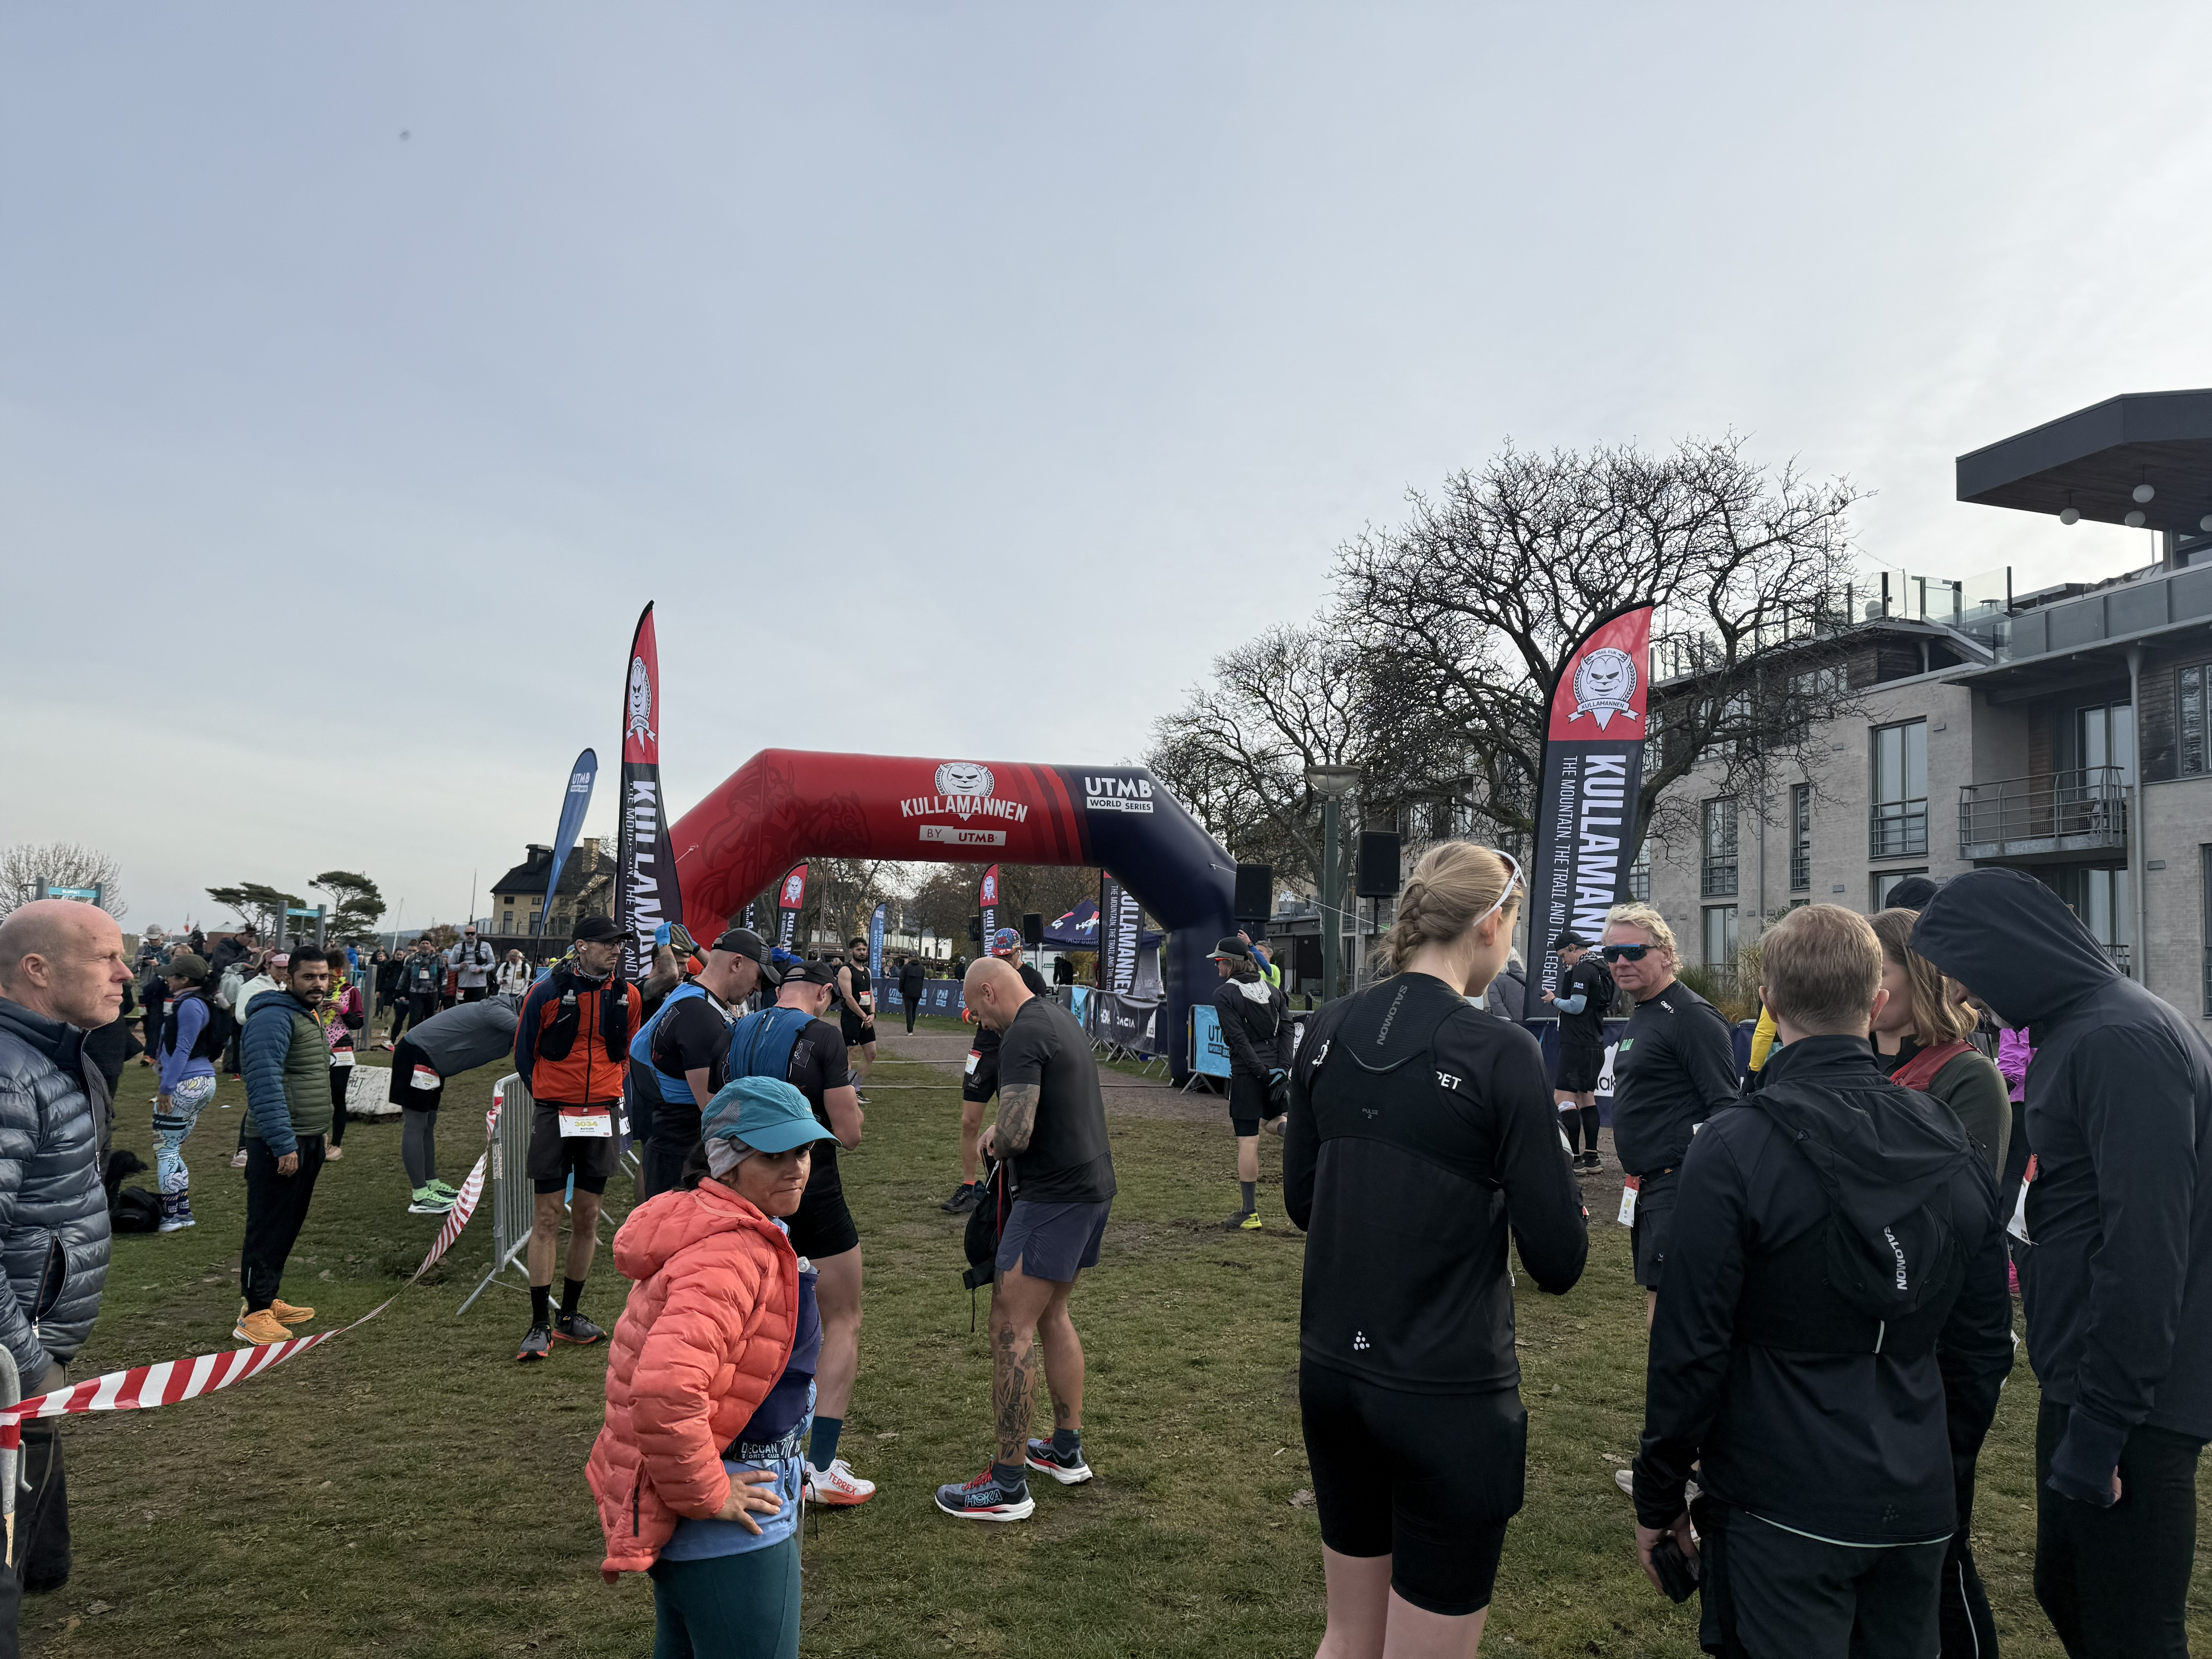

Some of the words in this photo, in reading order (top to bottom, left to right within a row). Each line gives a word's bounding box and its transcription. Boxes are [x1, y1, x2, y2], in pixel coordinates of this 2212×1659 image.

[1582, 701, 1624, 709] KULLAMANNEN
[1562, 756, 1577, 776] THE
[572, 772, 590, 784] UTMB
[1085, 777, 1152, 798] UTMB
[901, 795, 1028, 823] KULLAMANNEN
[1554, 780, 1575, 841] MOUNTAIN,
[927, 829, 942, 838] BY
[958, 833, 995, 843] UTMB
[1554, 844, 1570, 865] THE
[1551, 867, 1568, 899] TRAIL
[1109, 896, 1118, 927] MOUNTAIN,
[1549, 901, 1566, 924] AND
[625, 947, 638, 972] AND
[1542, 950, 1559, 991] LEGEND
[1376, 985, 1408, 1045] SALOMON
[829, 1472, 857, 1495] TERREX
[965, 1489, 1003, 1507] HOKA
